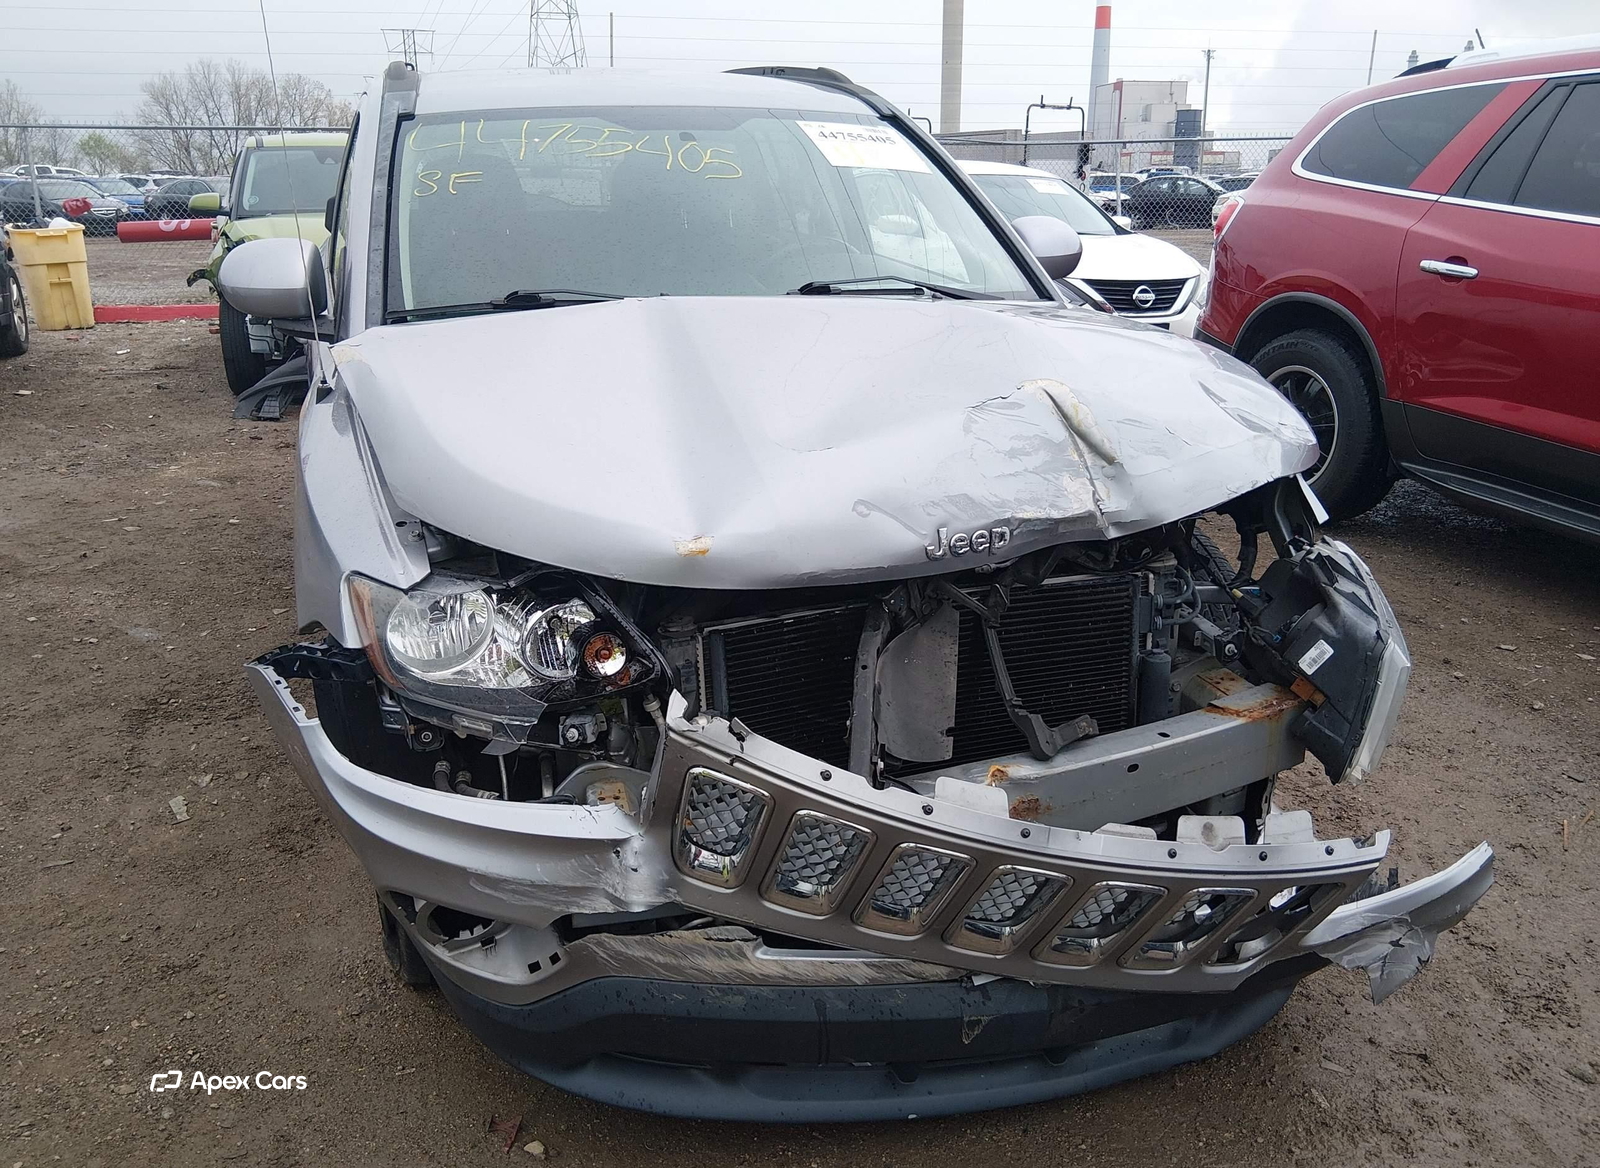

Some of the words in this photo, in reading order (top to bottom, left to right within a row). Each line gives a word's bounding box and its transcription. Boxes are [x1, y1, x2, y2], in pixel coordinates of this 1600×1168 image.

[817, 130, 897, 146] 44755405
[1252, 341, 1299, 365] UNTAIN
[924, 526, 1011, 561] Jeep
